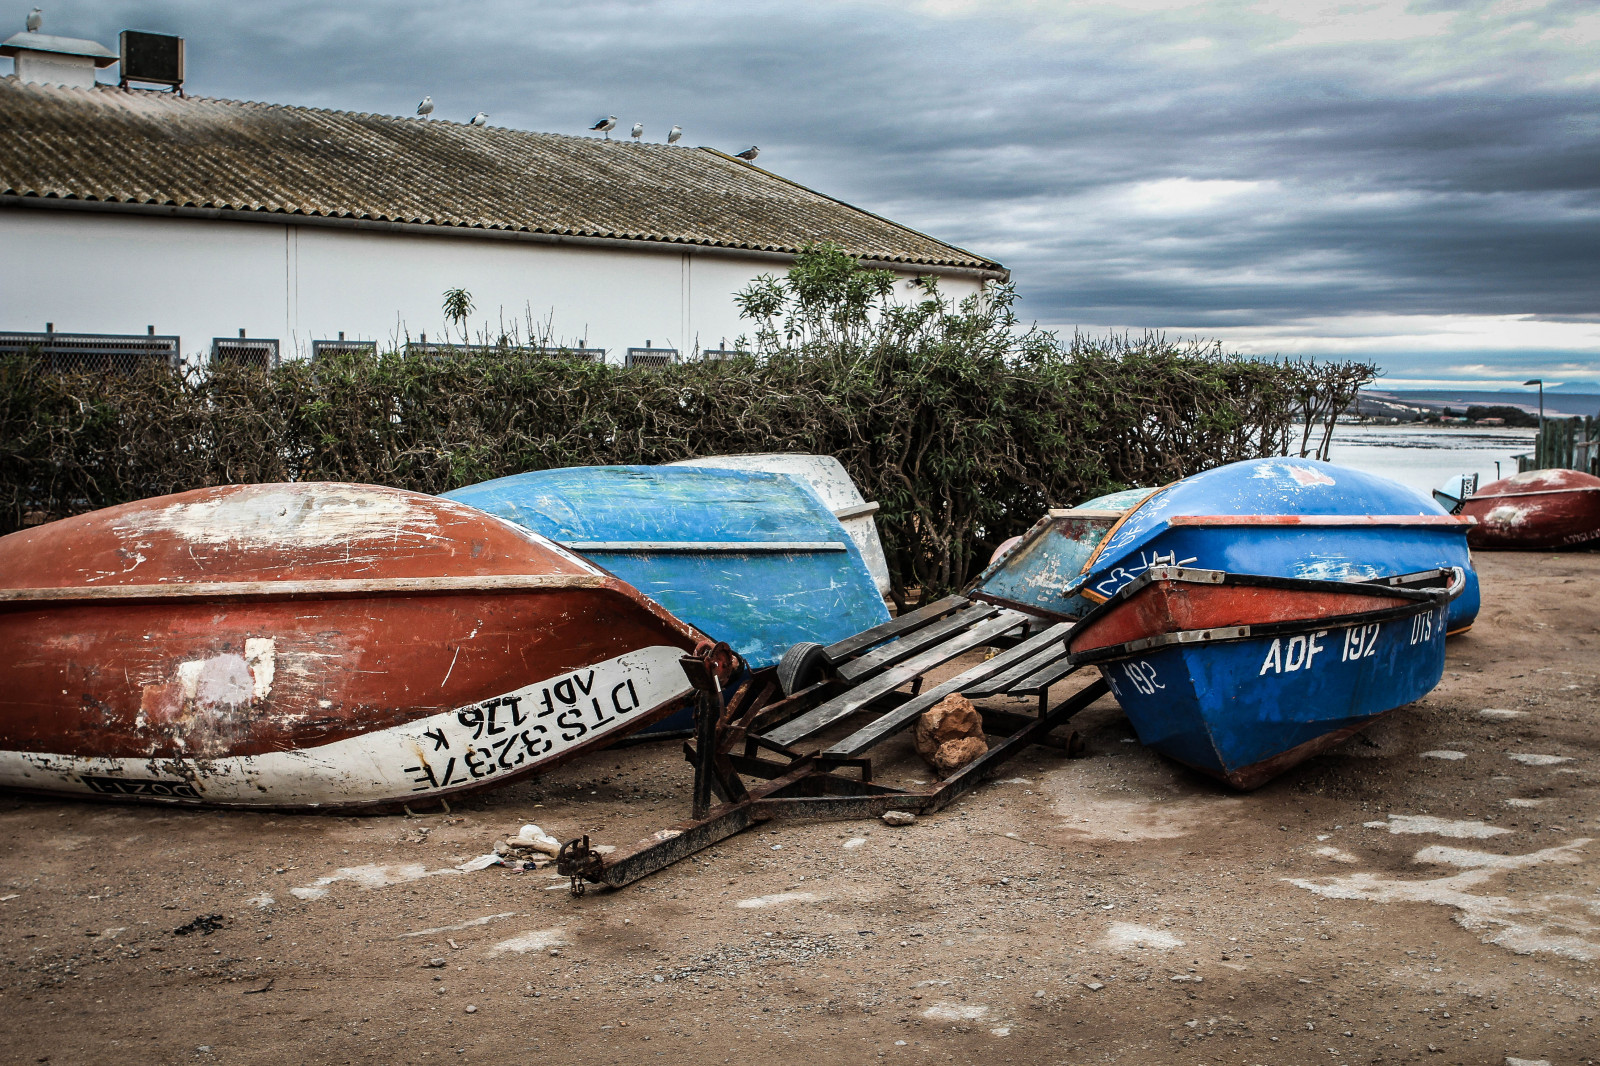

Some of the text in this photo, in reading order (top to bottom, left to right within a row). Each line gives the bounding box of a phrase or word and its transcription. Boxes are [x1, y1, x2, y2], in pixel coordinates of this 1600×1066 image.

[1259, 622, 1380, 676] ADF 192
[1410, 609, 1433, 646] DTS
[536, 669, 595, 719] ADF
[1121, 660, 1166, 695] 192
[404, 678, 640, 792] DTS 3237E
[423, 727, 450, 752] K
